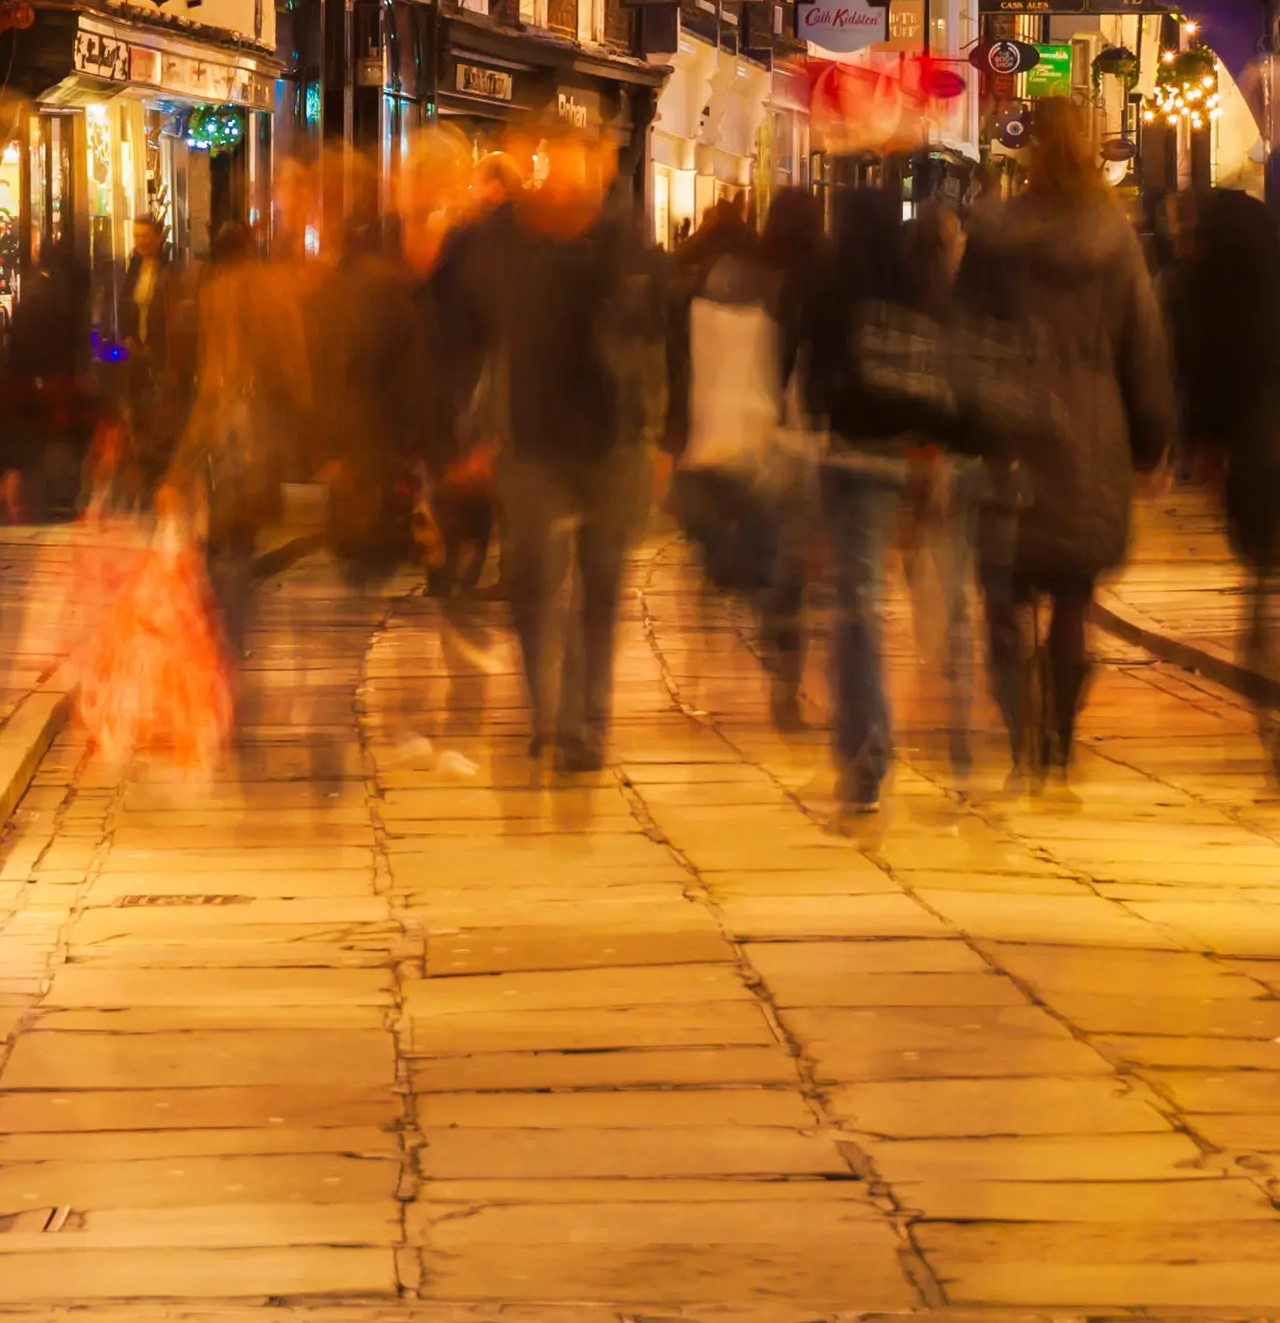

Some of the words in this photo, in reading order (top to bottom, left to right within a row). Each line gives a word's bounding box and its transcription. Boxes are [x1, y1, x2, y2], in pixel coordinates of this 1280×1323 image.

[1000, 1, 1024, 10] CASK
[1027, 1, 1049, 9] ALES
[805, 7, 832, 26] Cath
[832, 8, 879, 26] Kidston
